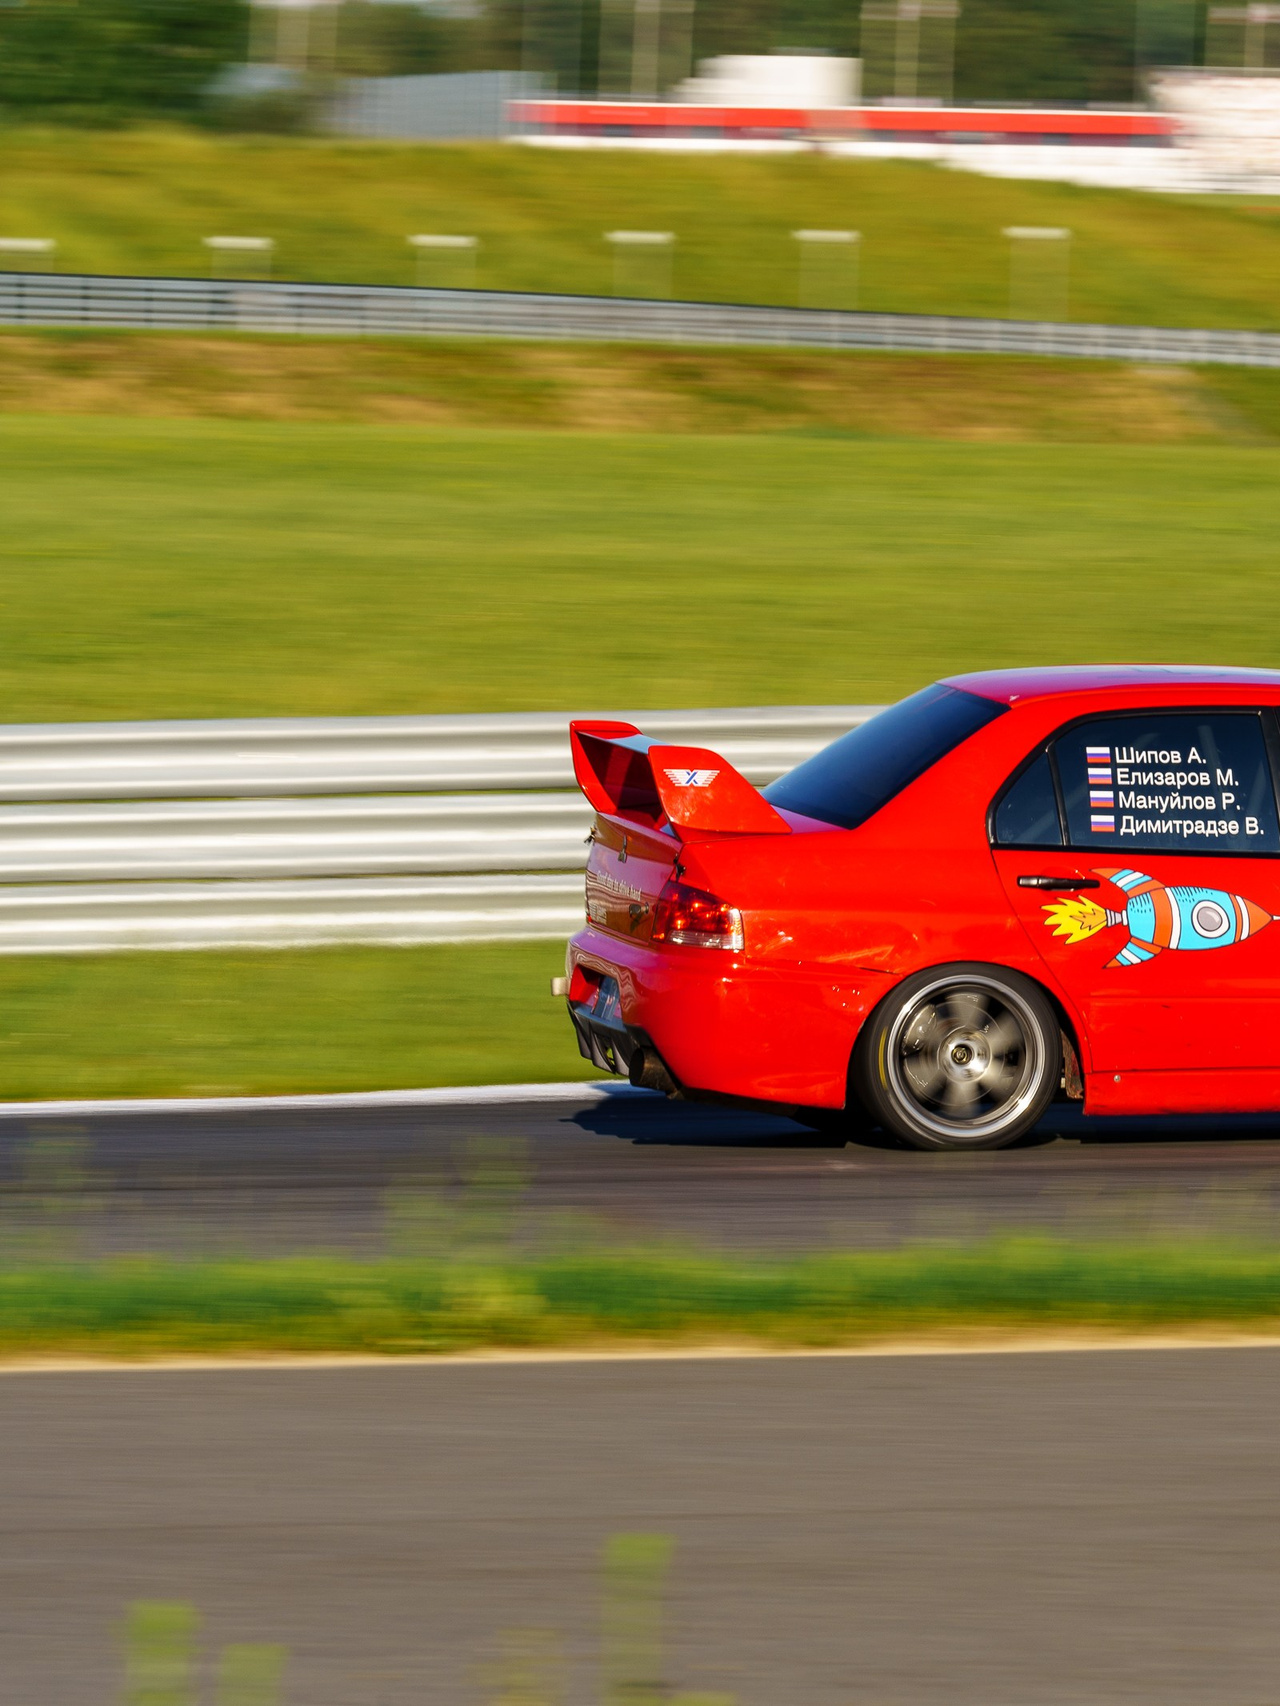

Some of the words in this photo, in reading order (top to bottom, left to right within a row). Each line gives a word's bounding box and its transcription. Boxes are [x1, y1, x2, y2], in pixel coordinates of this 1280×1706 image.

[1115, 746, 1182, 764] Шипов
[1187, 746, 1207, 764] А.
[1116, 768, 1211, 789] Елизаров
[1216, 768, 1239, 786] М.
[1118, 791, 1216, 813] Мануйлов
[1221, 792, 1241, 810] Р.
[1120, 815, 1239, 838] Димитрадзе
[1245, 817, 1265, 835] В.
